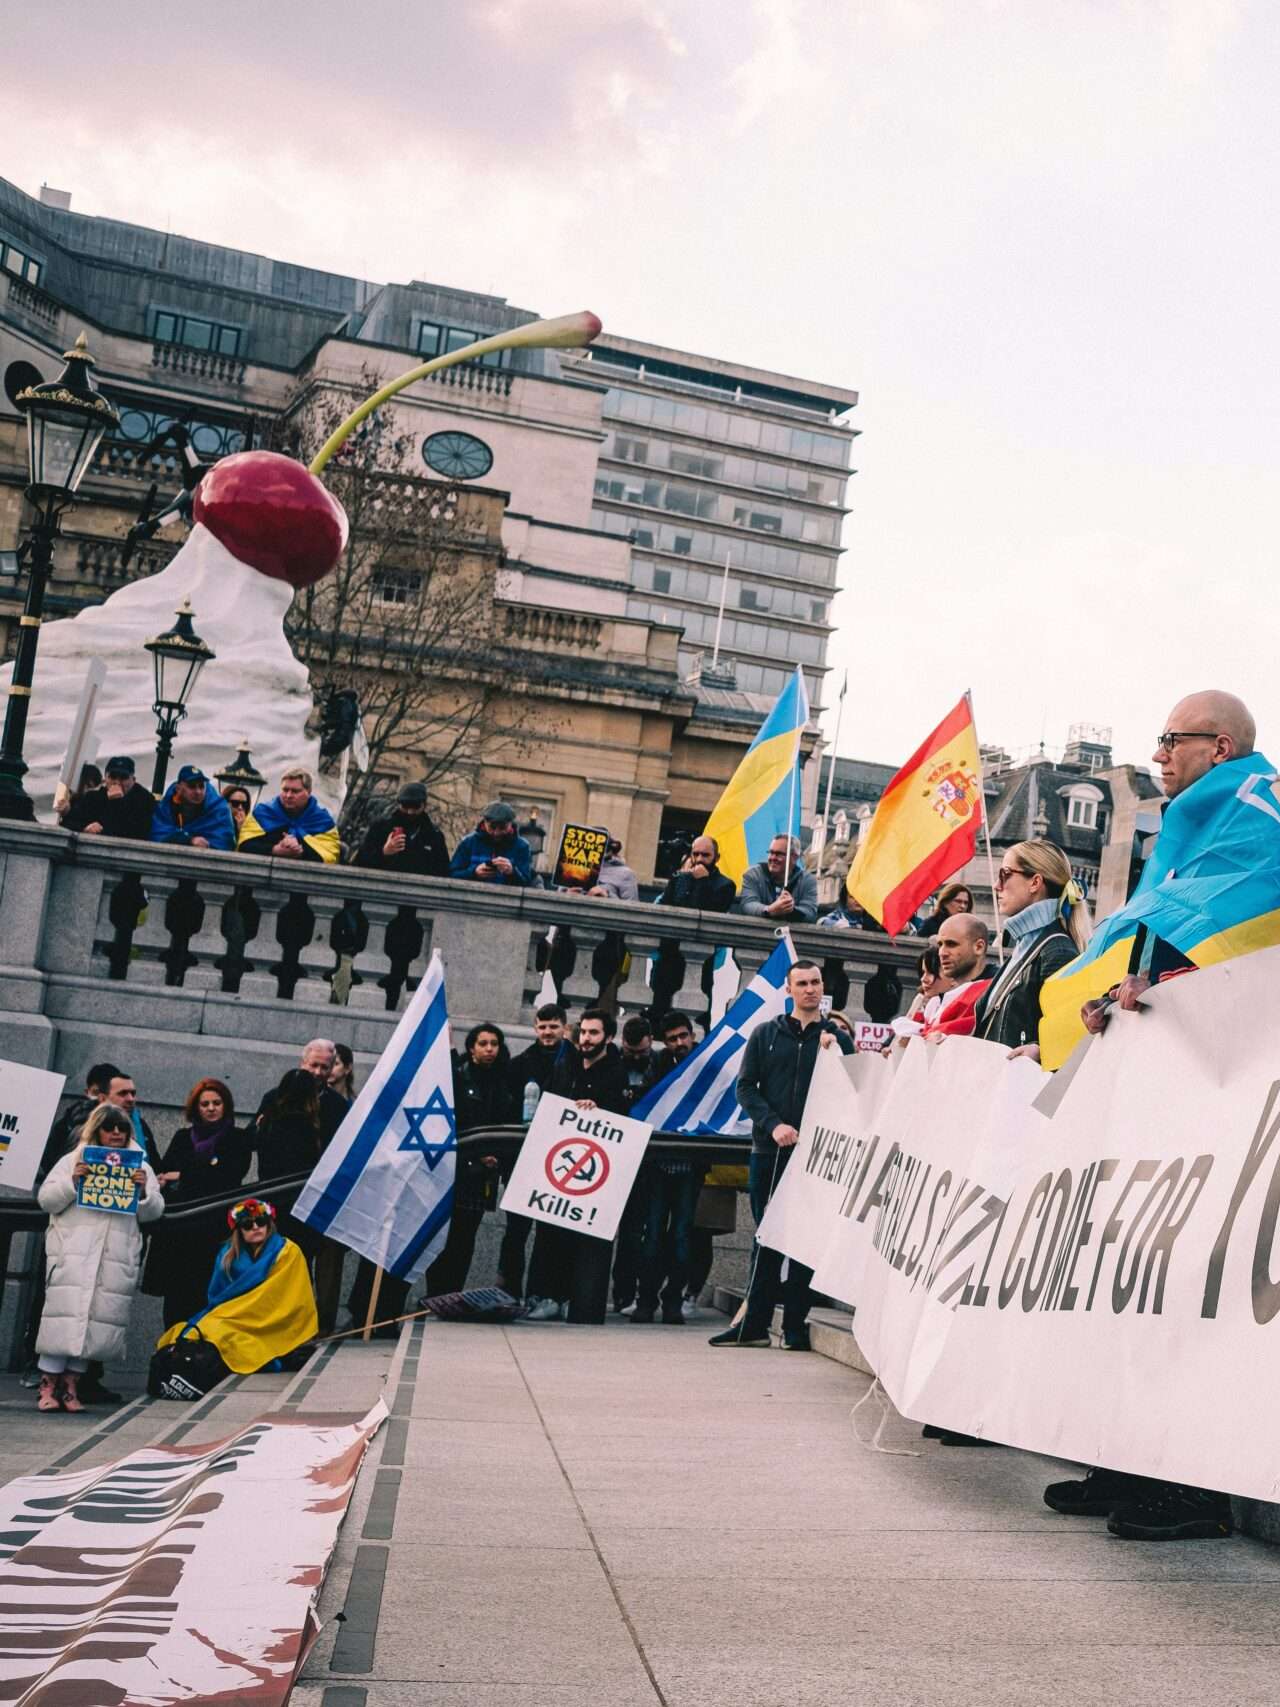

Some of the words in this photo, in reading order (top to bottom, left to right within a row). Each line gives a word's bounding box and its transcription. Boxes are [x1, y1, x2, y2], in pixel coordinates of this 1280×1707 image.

[566, 828, 607, 844] STOP
[563, 845, 601, 865] WAR
[559, 1108, 624, 1143] Putin
[83, 1174, 136, 1190] ZONE
[82, 1193, 134, 1209] NOW
[1085, 1154, 1215, 1315] FOR
